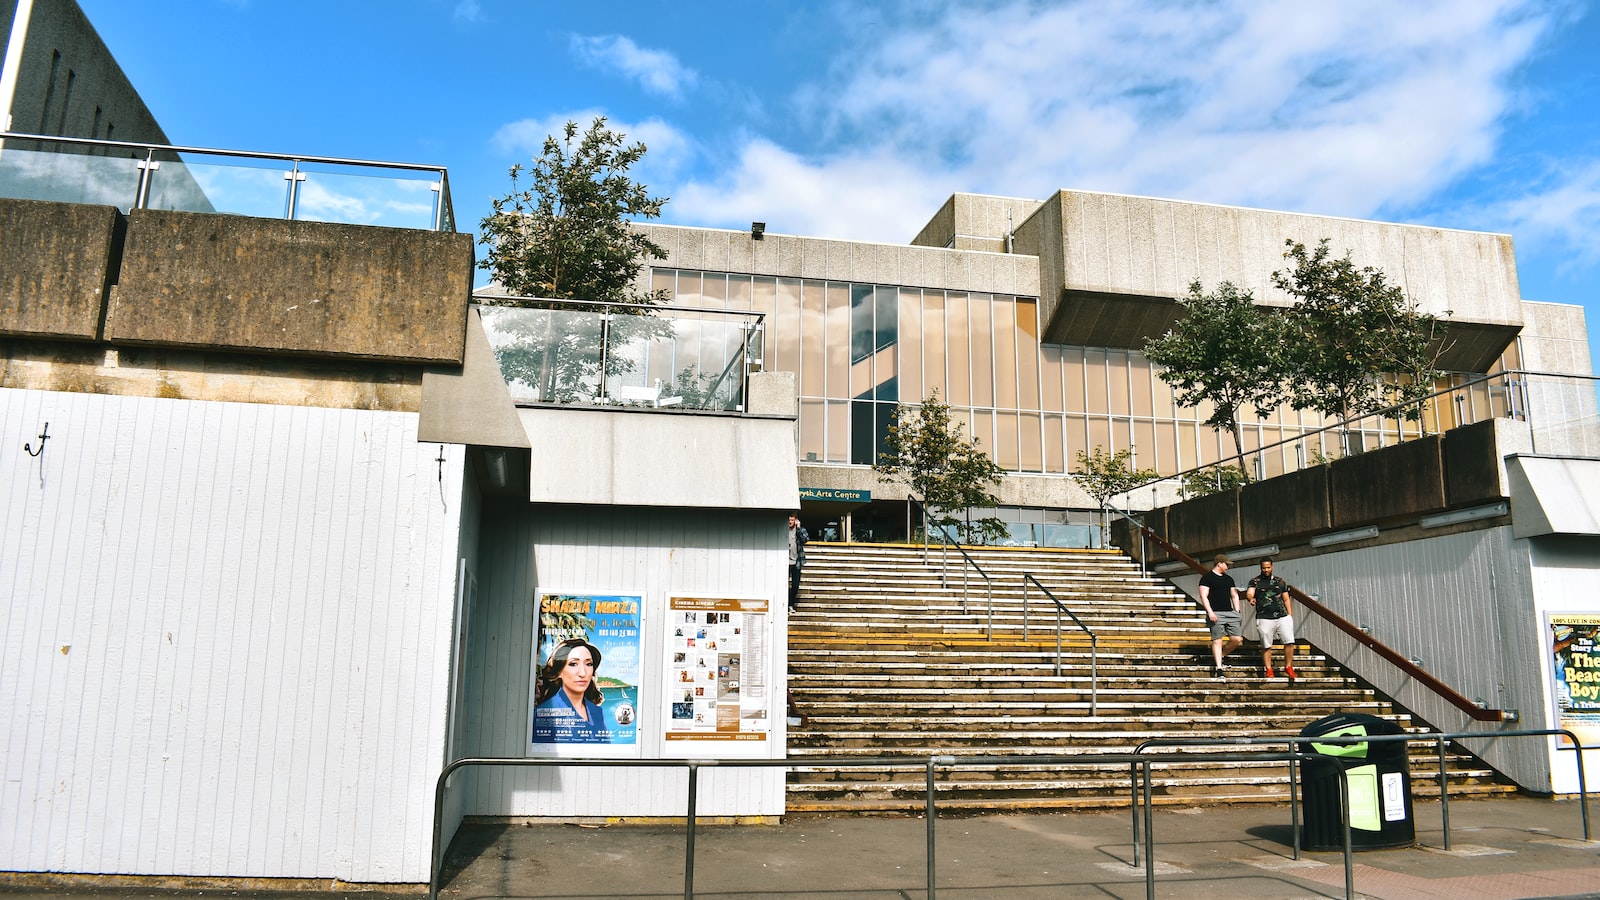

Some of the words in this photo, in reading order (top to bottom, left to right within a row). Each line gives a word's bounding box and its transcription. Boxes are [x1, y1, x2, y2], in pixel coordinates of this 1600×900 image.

[816, 490, 832, 498] Arts
[834, 490, 860, 498] Centre
[541, 600, 590, 613] SHAZIA
[595, 601, 638, 614] MIRZA
[1571, 644, 1591, 653] Story
[1571, 653, 1600, 668] The
[1565, 667, 1600, 682] Beac
[1569, 682, 1600, 700] Boy
